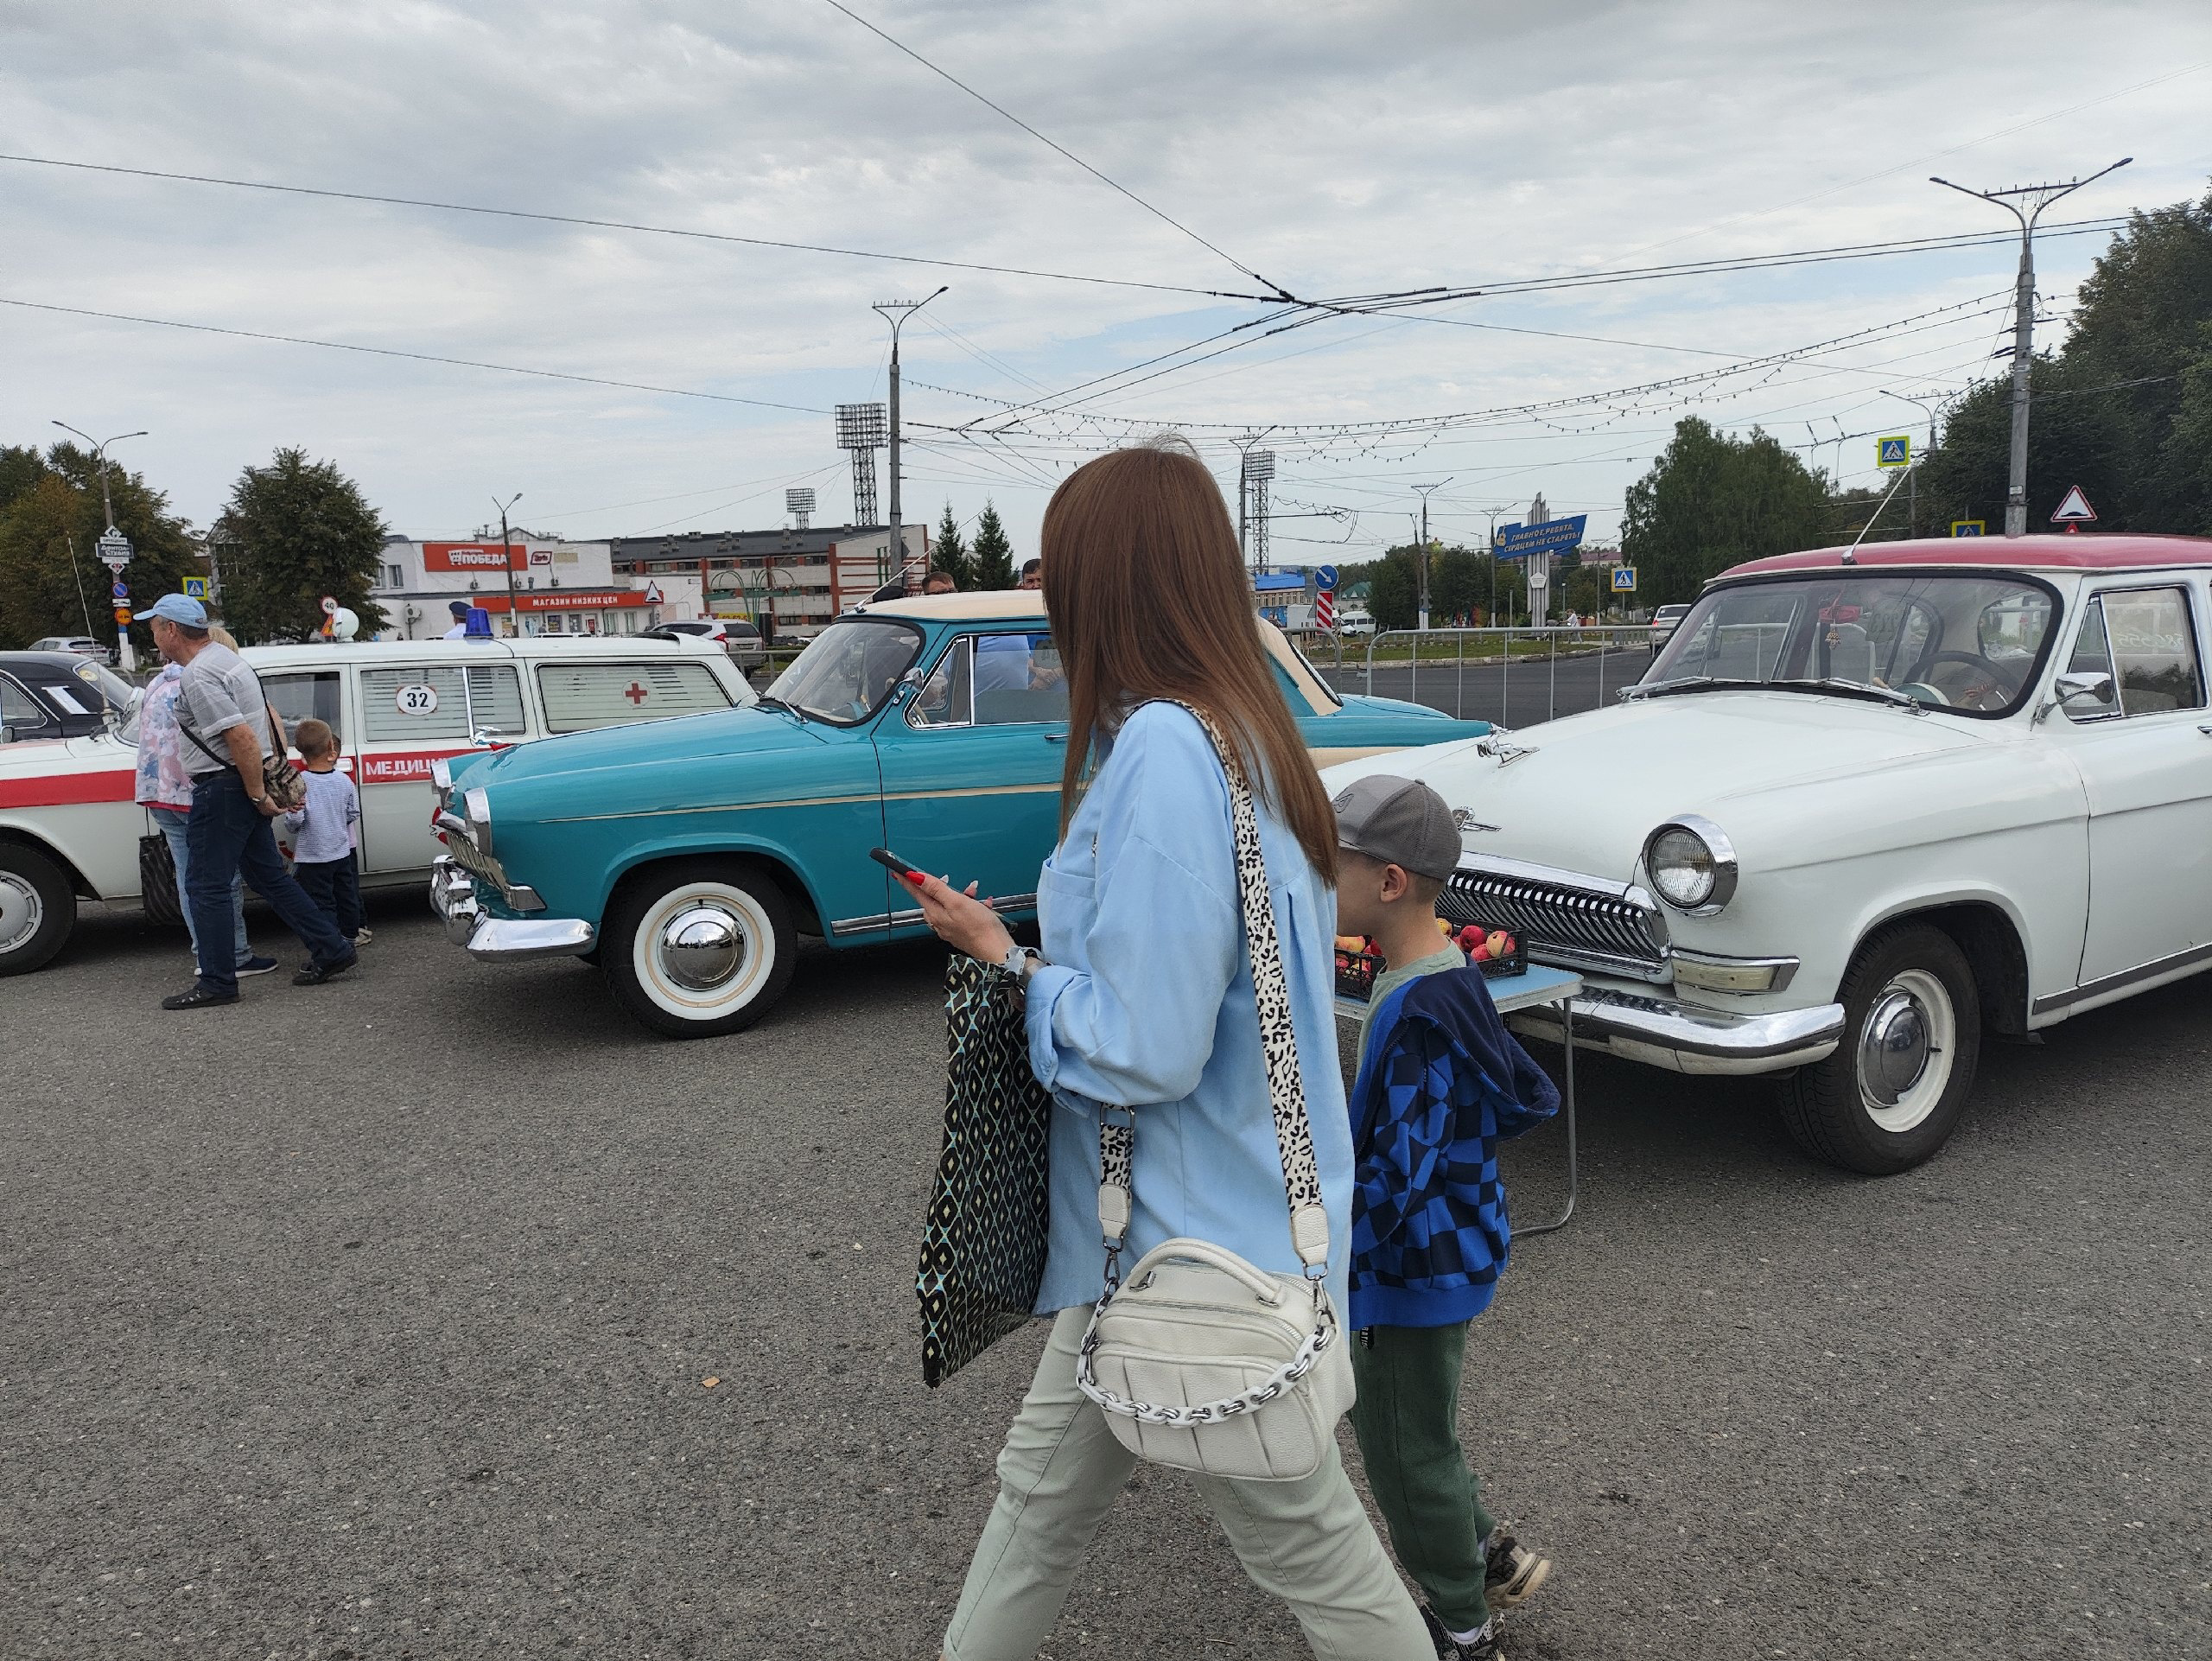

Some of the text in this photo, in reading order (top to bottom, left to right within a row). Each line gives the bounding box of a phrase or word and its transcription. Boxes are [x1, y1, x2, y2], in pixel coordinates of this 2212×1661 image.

[1504, 531, 1581, 553] СЕРДЦЕМ НЕ СТАРЕТЬ!
[533, 595, 618, 607] МАГАЗИН НИЗКИХ ЦЕН
[406, 692, 429, 708] 32
